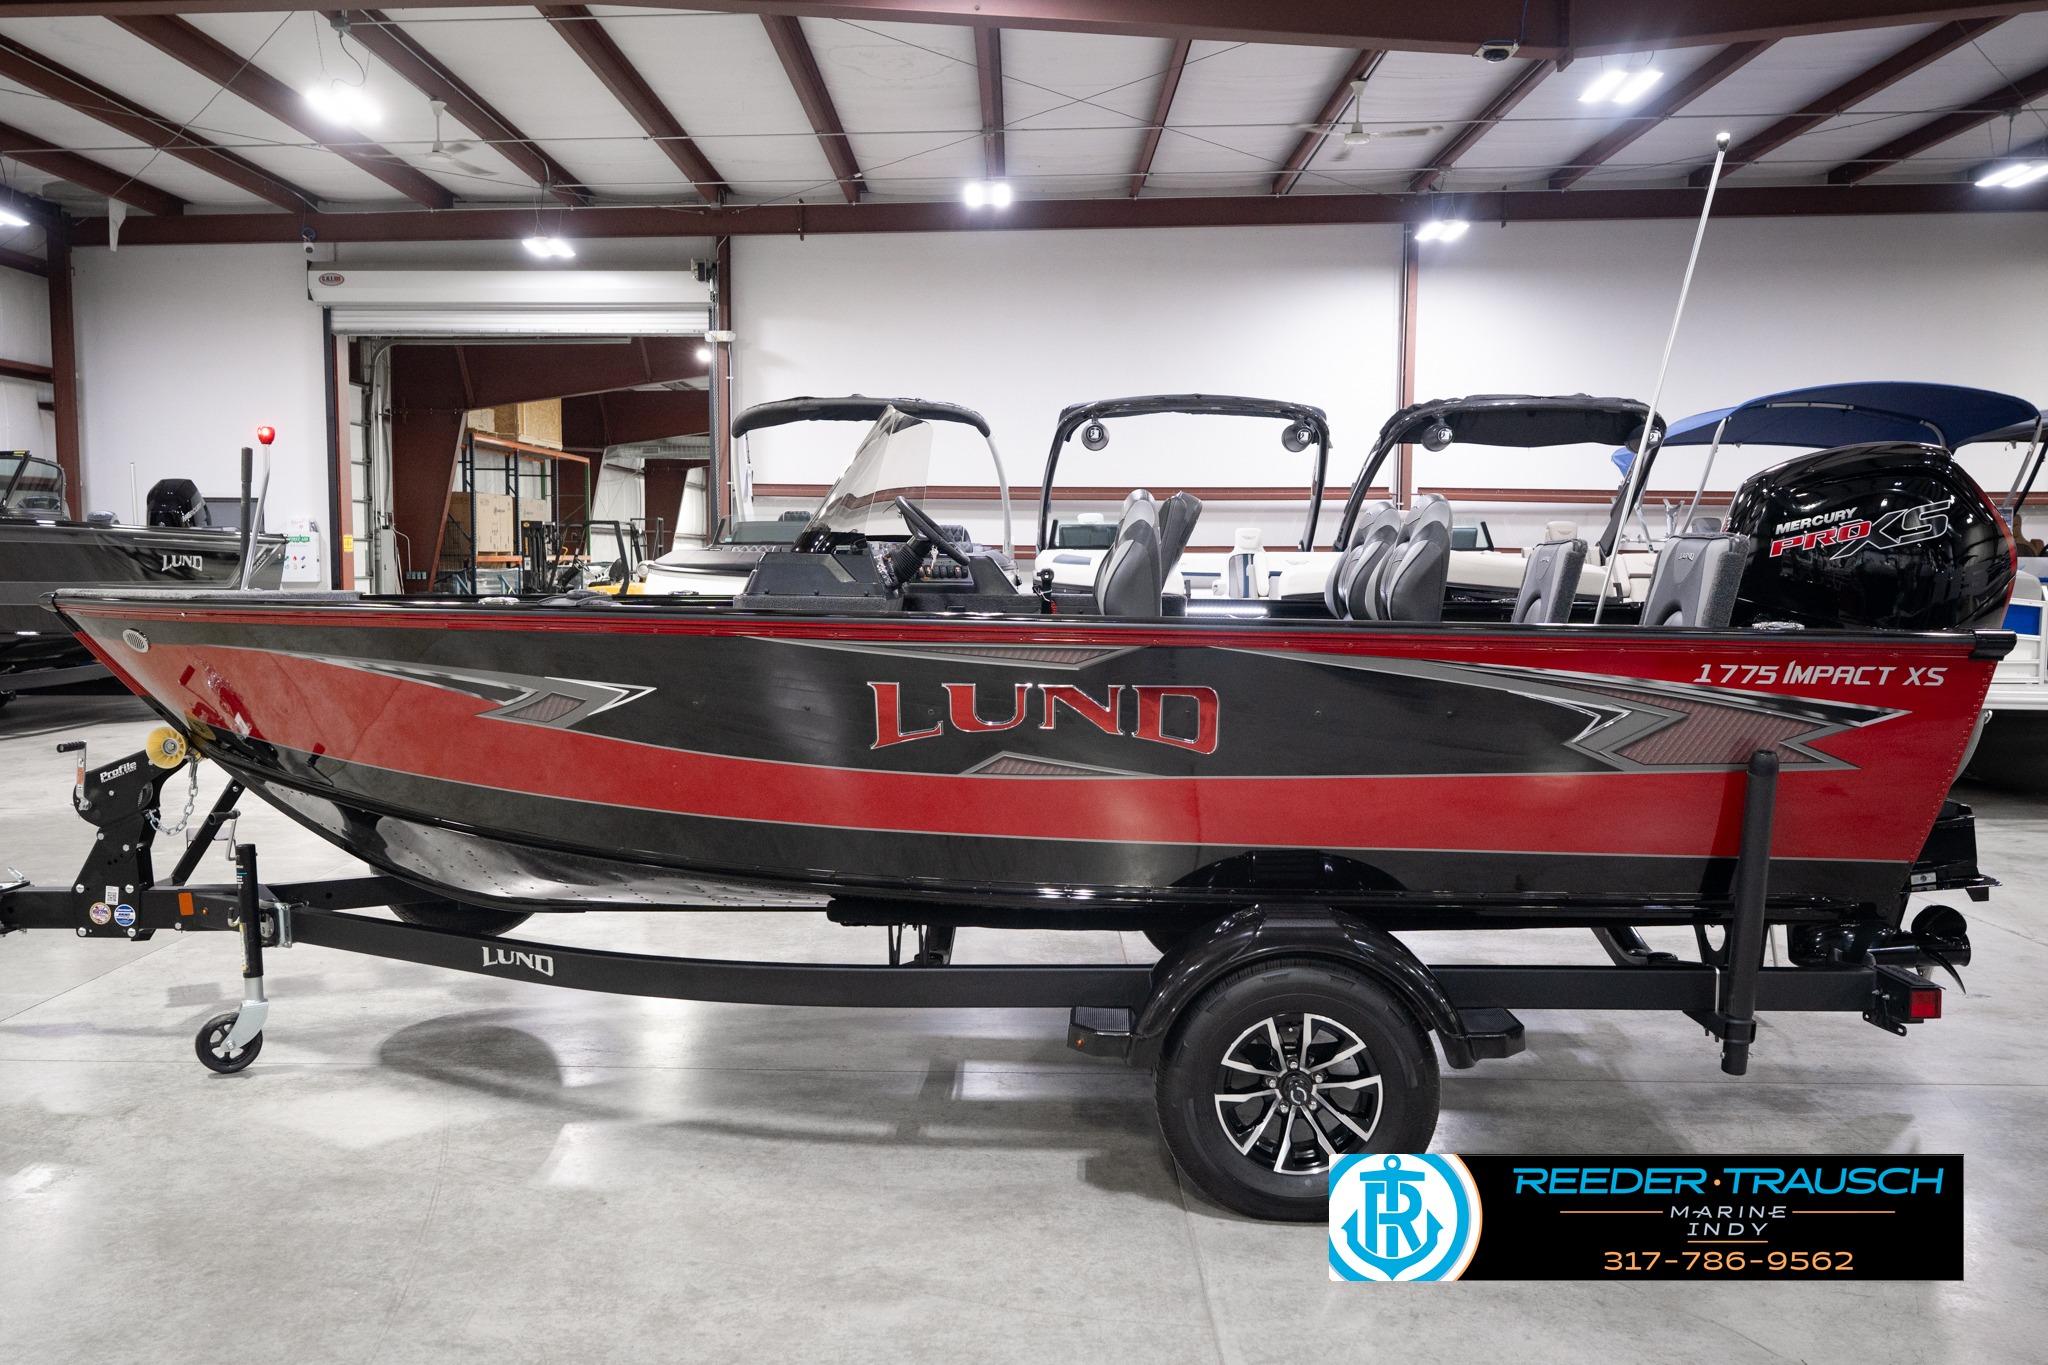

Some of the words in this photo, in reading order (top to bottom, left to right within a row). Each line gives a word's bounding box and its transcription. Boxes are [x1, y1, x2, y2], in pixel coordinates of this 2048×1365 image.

[1769, 520, 1872, 558] PRO
[1829, 499, 1952, 561] XS
[1775, 507, 1857, 534] MERCURY
[161, 554, 203, 572] LUND
[1693, 663, 1780, 685] 1775
[1782, 659, 1898, 686] IMPACT
[1902, 667, 1949, 687] XS
[866, 681, 1221, 755] LUND
[99, 761, 137, 782] Profile
[481, 946, 555, 977] LUND
